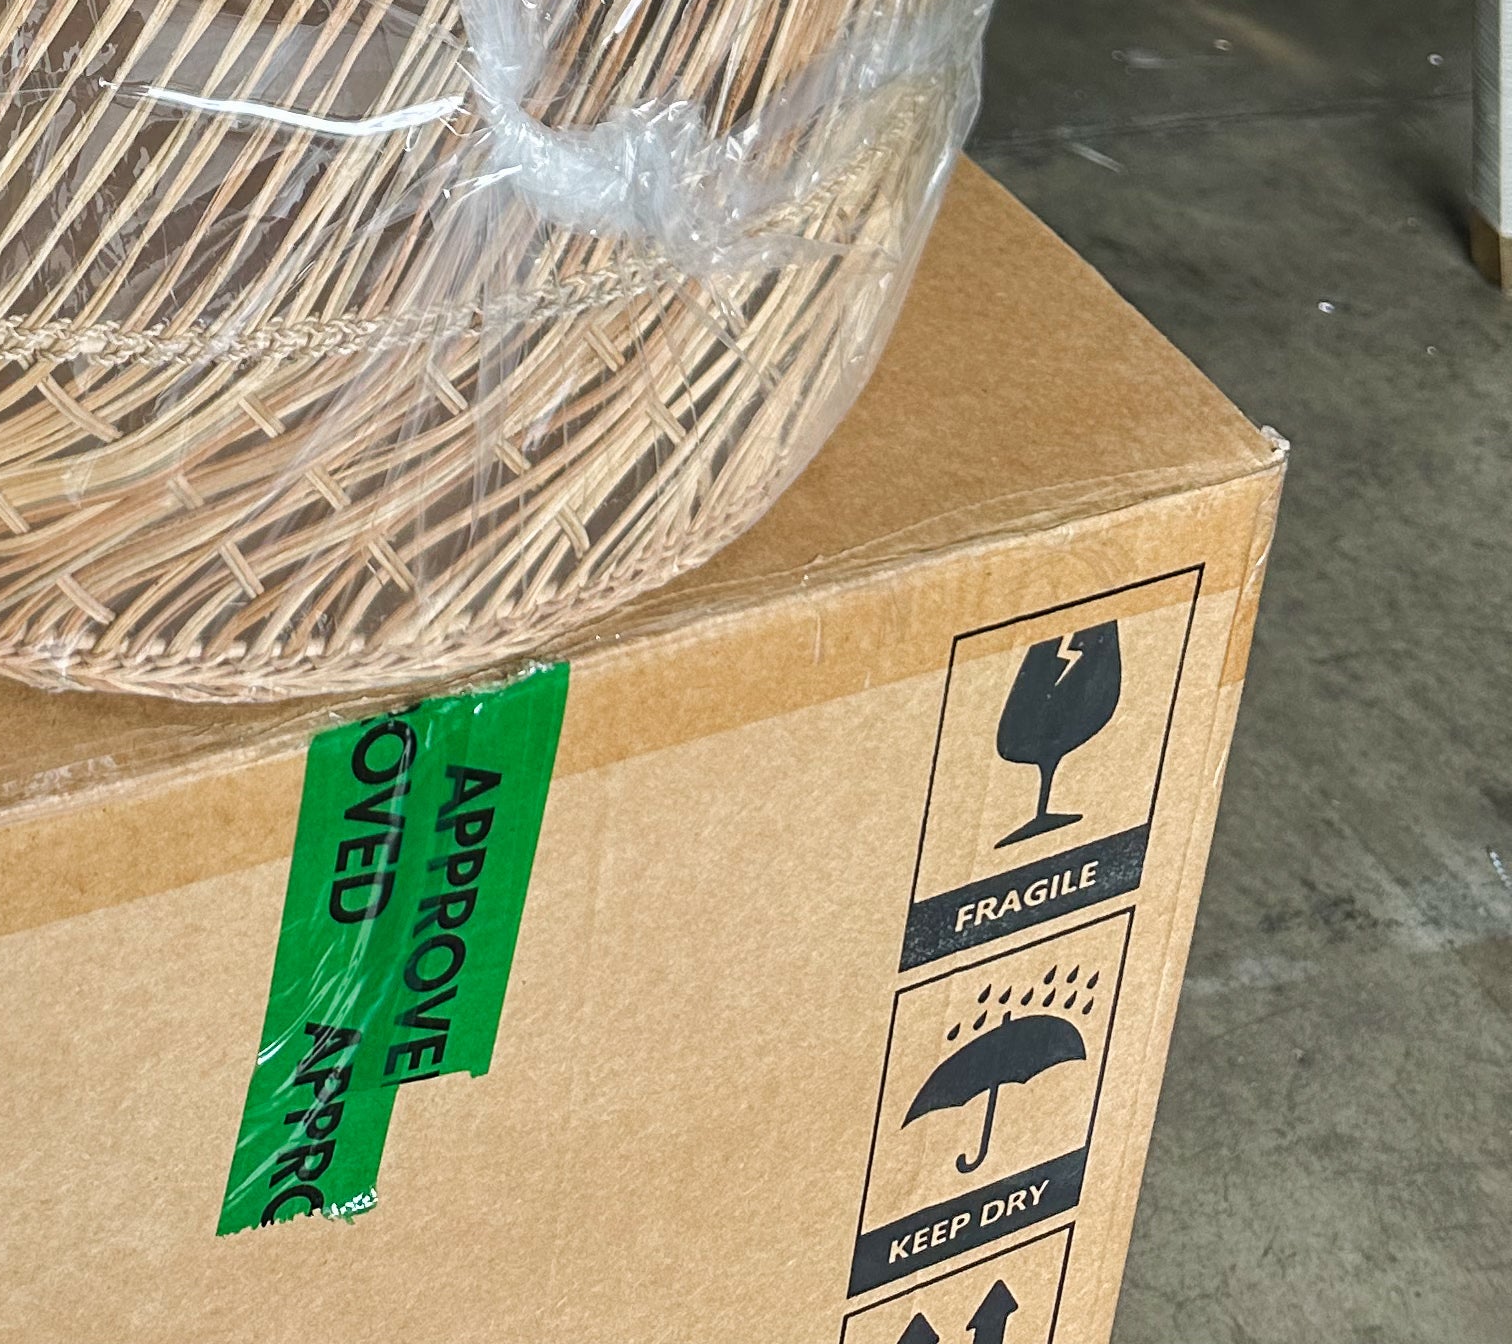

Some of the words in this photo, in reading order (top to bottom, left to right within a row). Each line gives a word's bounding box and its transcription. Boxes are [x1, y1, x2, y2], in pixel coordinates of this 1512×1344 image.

[329, 702, 422, 924] OVED
[380, 764, 502, 1088] APPROVE
[954, 860, 1099, 933] FRAGILE
[888, 1211, 972, 1264] KEEP
[979, 1178, 1050, 1227] DRY
